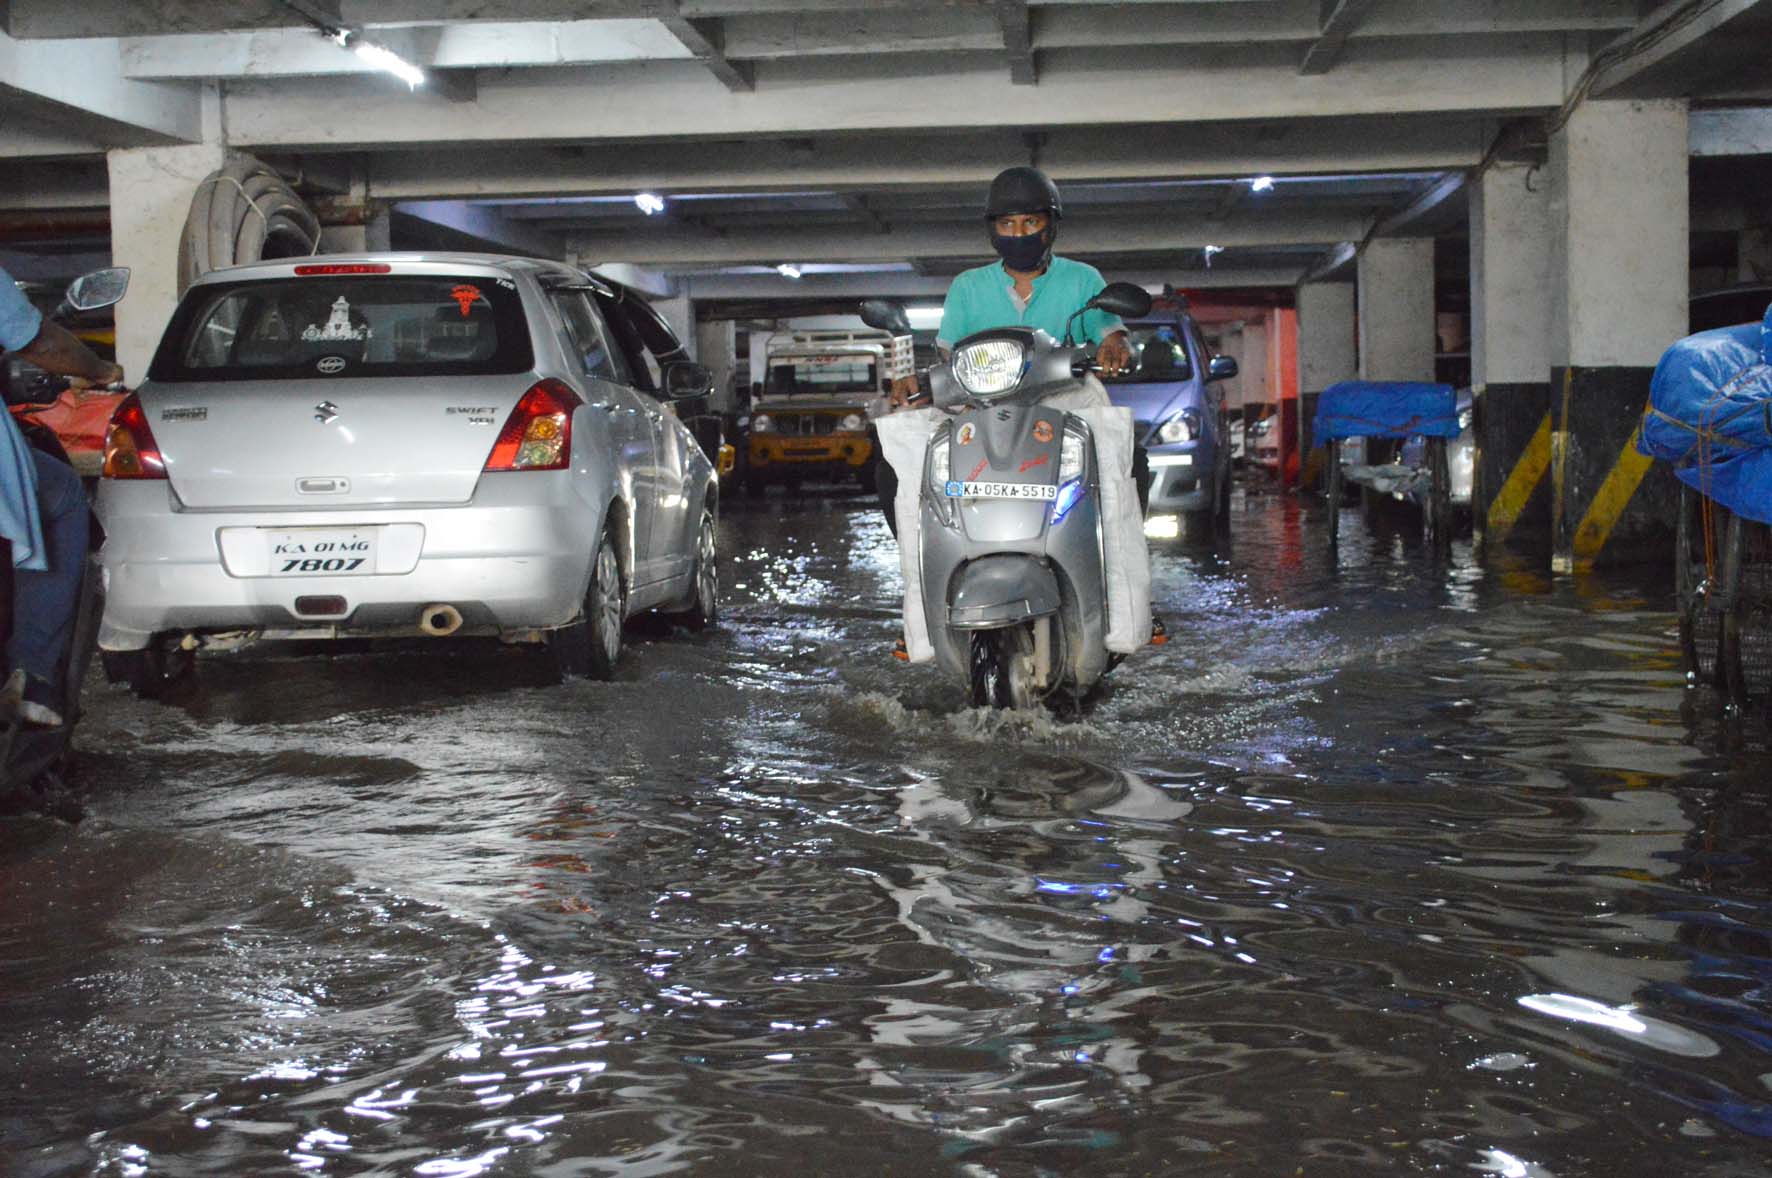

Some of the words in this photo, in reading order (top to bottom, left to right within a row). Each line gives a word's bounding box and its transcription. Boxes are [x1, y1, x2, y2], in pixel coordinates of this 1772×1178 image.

[446, 406, 498, 415] SWIFT
[274, 543, 307, 554] KA
[280, 557, 367, 573] 7807
